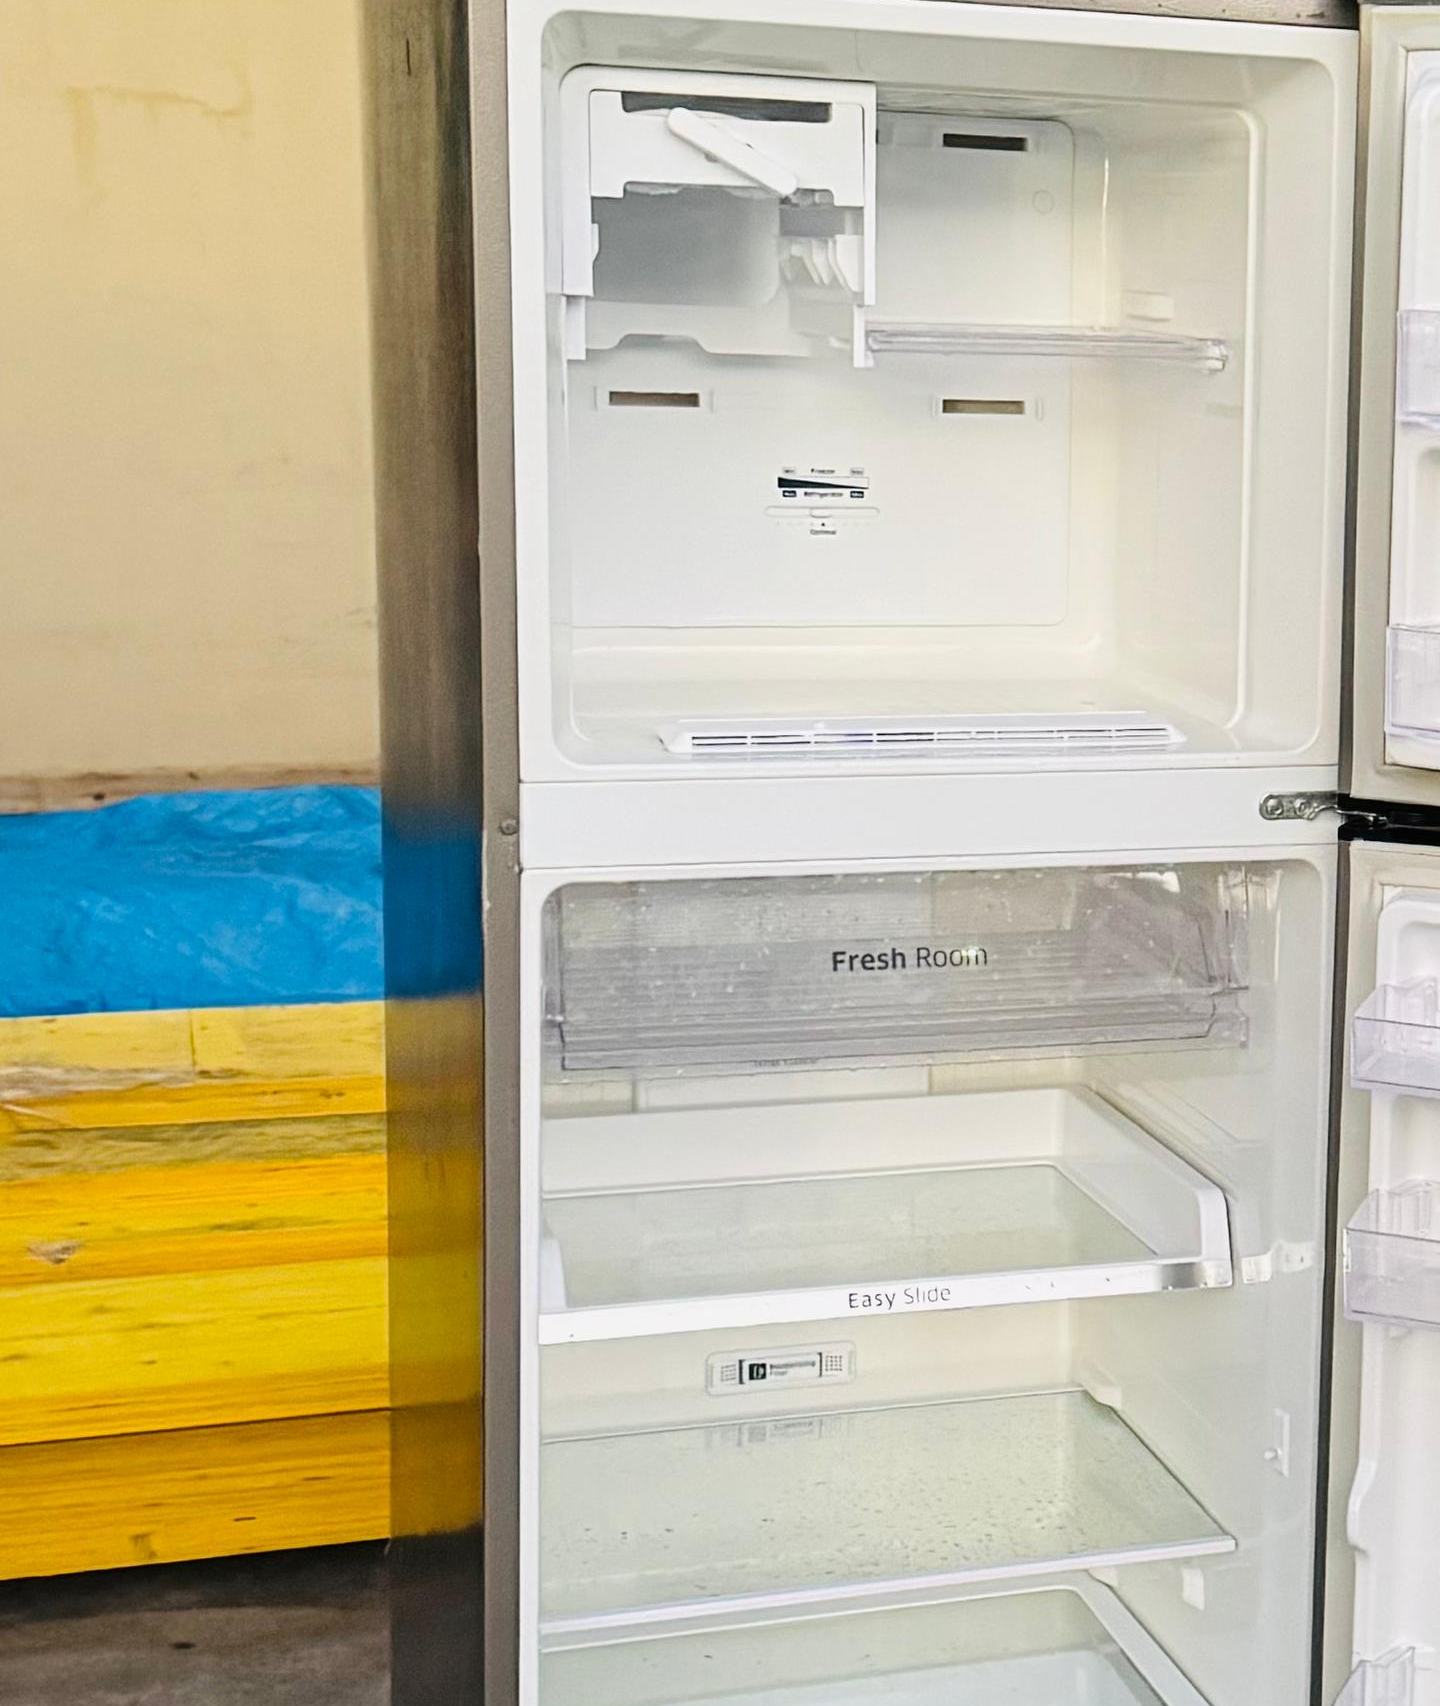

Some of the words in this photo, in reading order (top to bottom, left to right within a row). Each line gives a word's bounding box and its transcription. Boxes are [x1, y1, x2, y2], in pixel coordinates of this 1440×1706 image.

[832, 947, 906, 972] Fresh
[916, 946, 988, 969] Room
[848, 1291, 896, 1311] Easy
[903, 1285, 952, 1305] Slide
